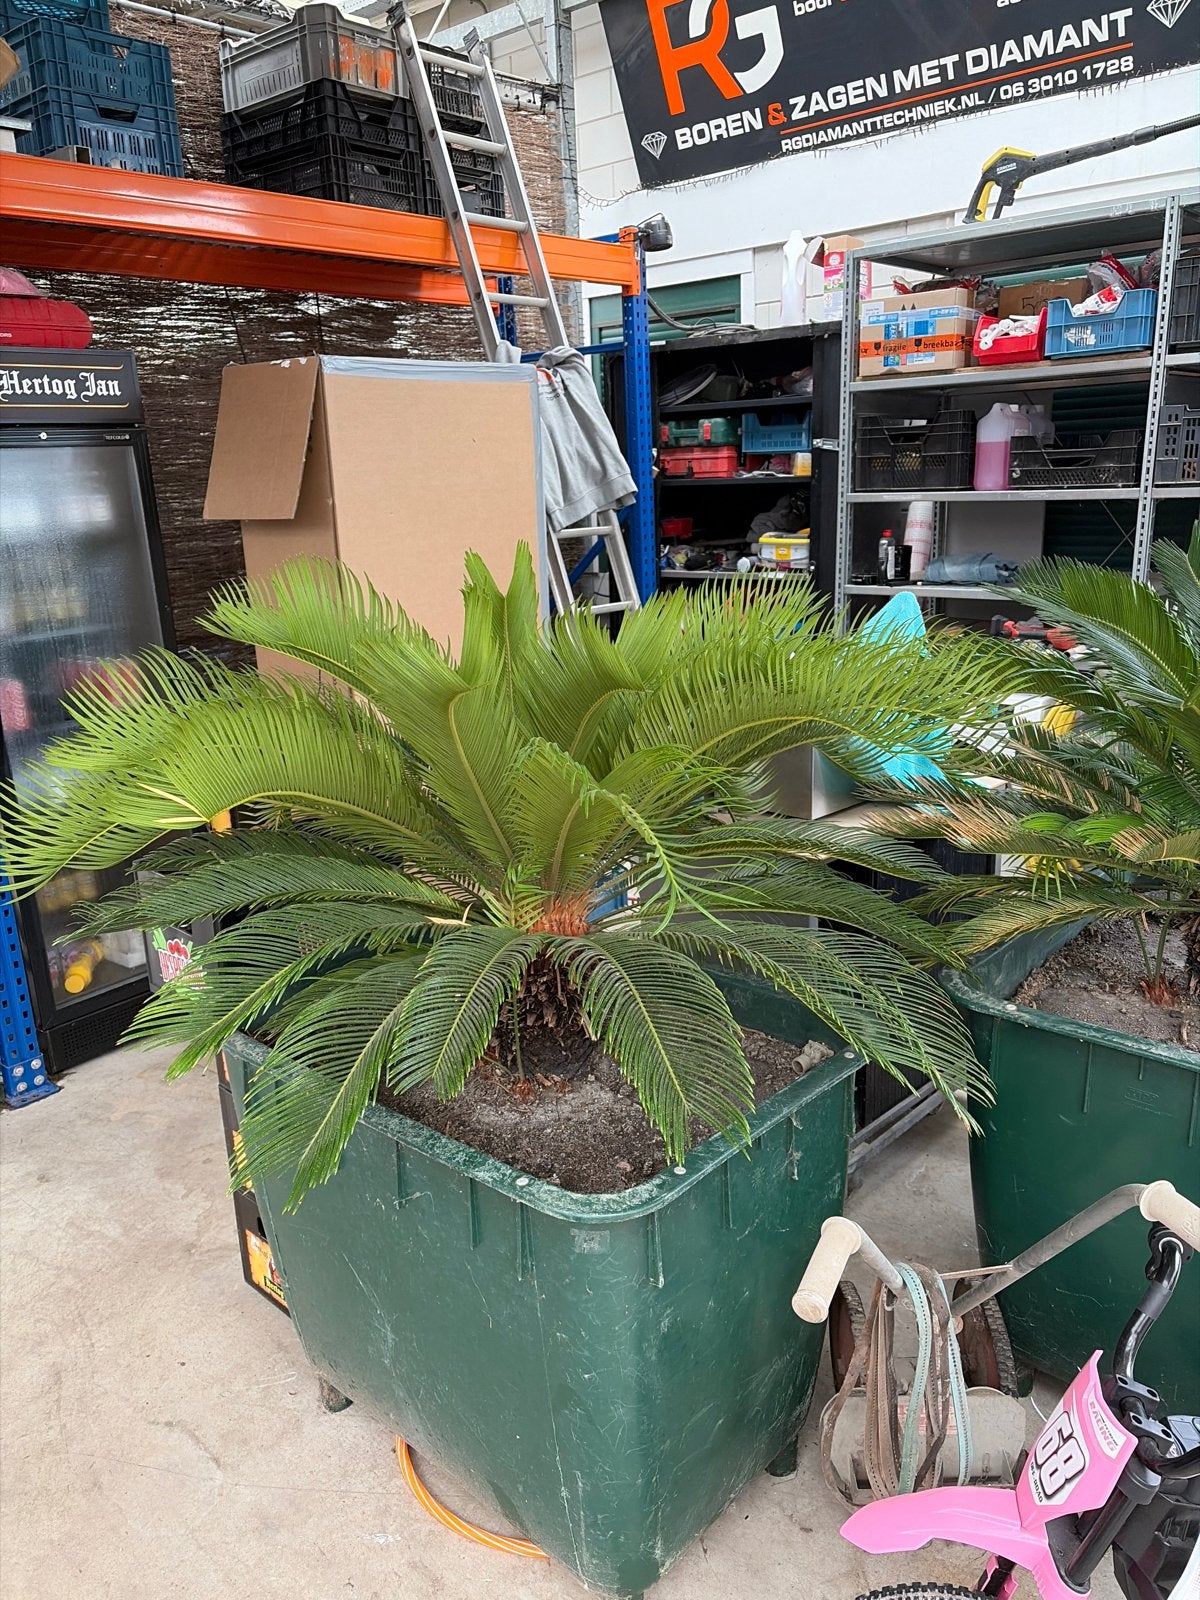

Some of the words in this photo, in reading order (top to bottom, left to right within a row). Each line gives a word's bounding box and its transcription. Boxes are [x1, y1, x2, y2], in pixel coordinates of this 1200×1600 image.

[675, 107, 764, 151] BOREN
[767, 102, 788, 126] &
[789, 73, 889, 121] ZAGEN
[892, 53, 960, 94] MET
[965, 7, 1133, 76] DIAMANT
[781, 92, 985, 153] RGDIAMANTTECHNIEK.NL
[987, 87, 997, 104] /
[1000, 81, 1025, 100] 06
[1028, 69, 1078, 93] 3010
[1082, 55, 1134, 81] 1728
[0, 370, 78, 402] Hertog
[79, 372, 121, 402] Jan
[882, 343, 907, 353] fragile
[1034, 1410, 1086, 1499] 68
